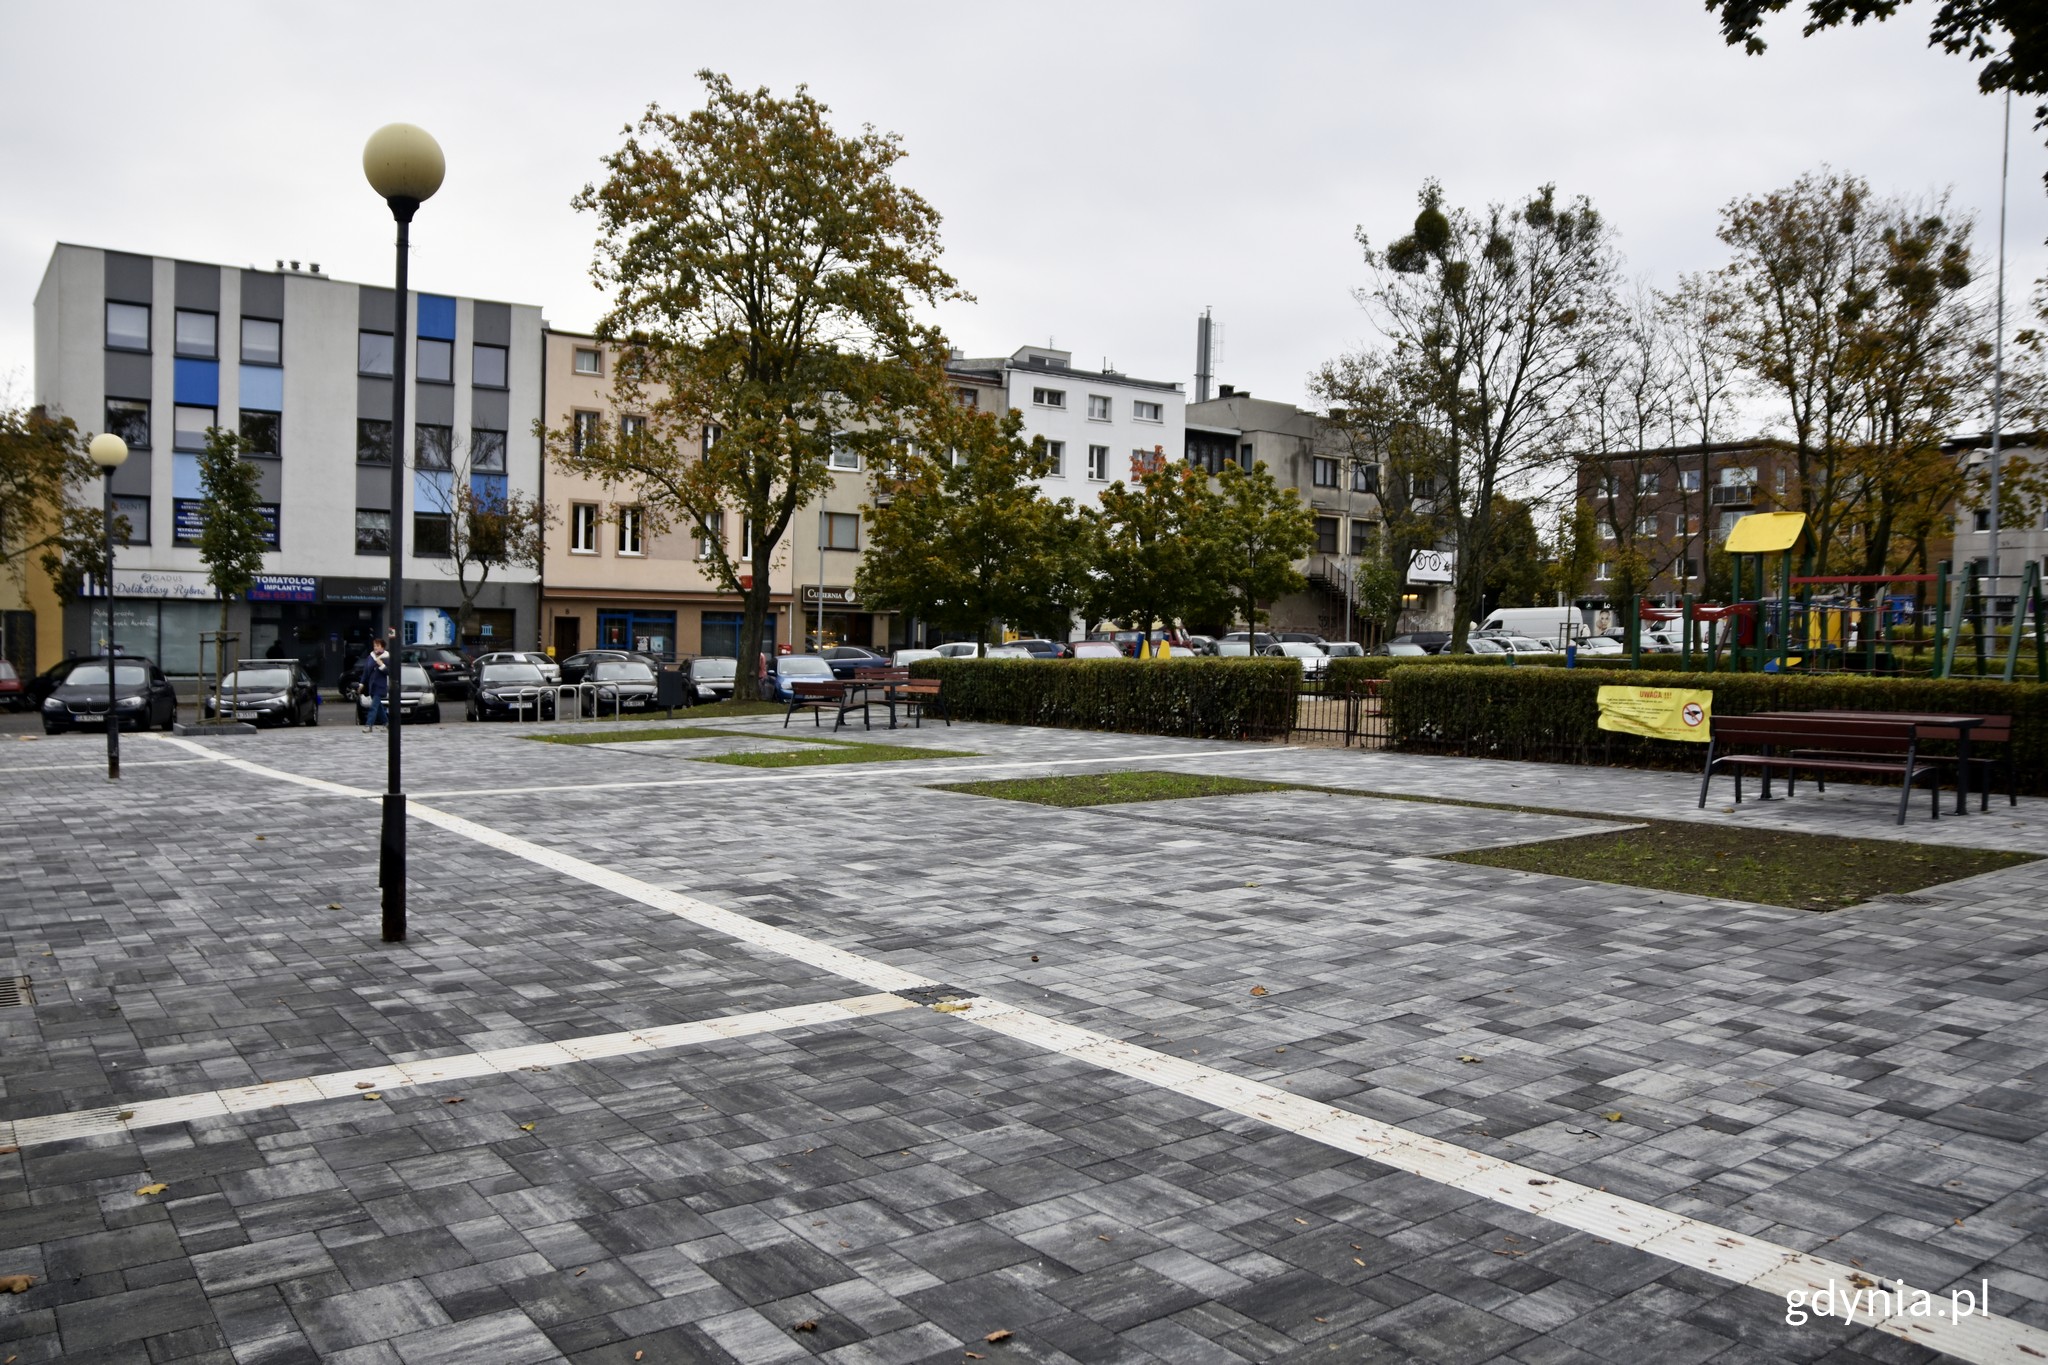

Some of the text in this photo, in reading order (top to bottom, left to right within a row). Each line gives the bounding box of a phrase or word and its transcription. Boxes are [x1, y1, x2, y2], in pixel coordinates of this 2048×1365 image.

[152, 574, 183, 582] GADUS
[114, 582, 206, 597] Delikatesy Rybne
[807, 588, 843, 599] CUIERNIA
[1640, 690, 1662, 699] UWAGA
